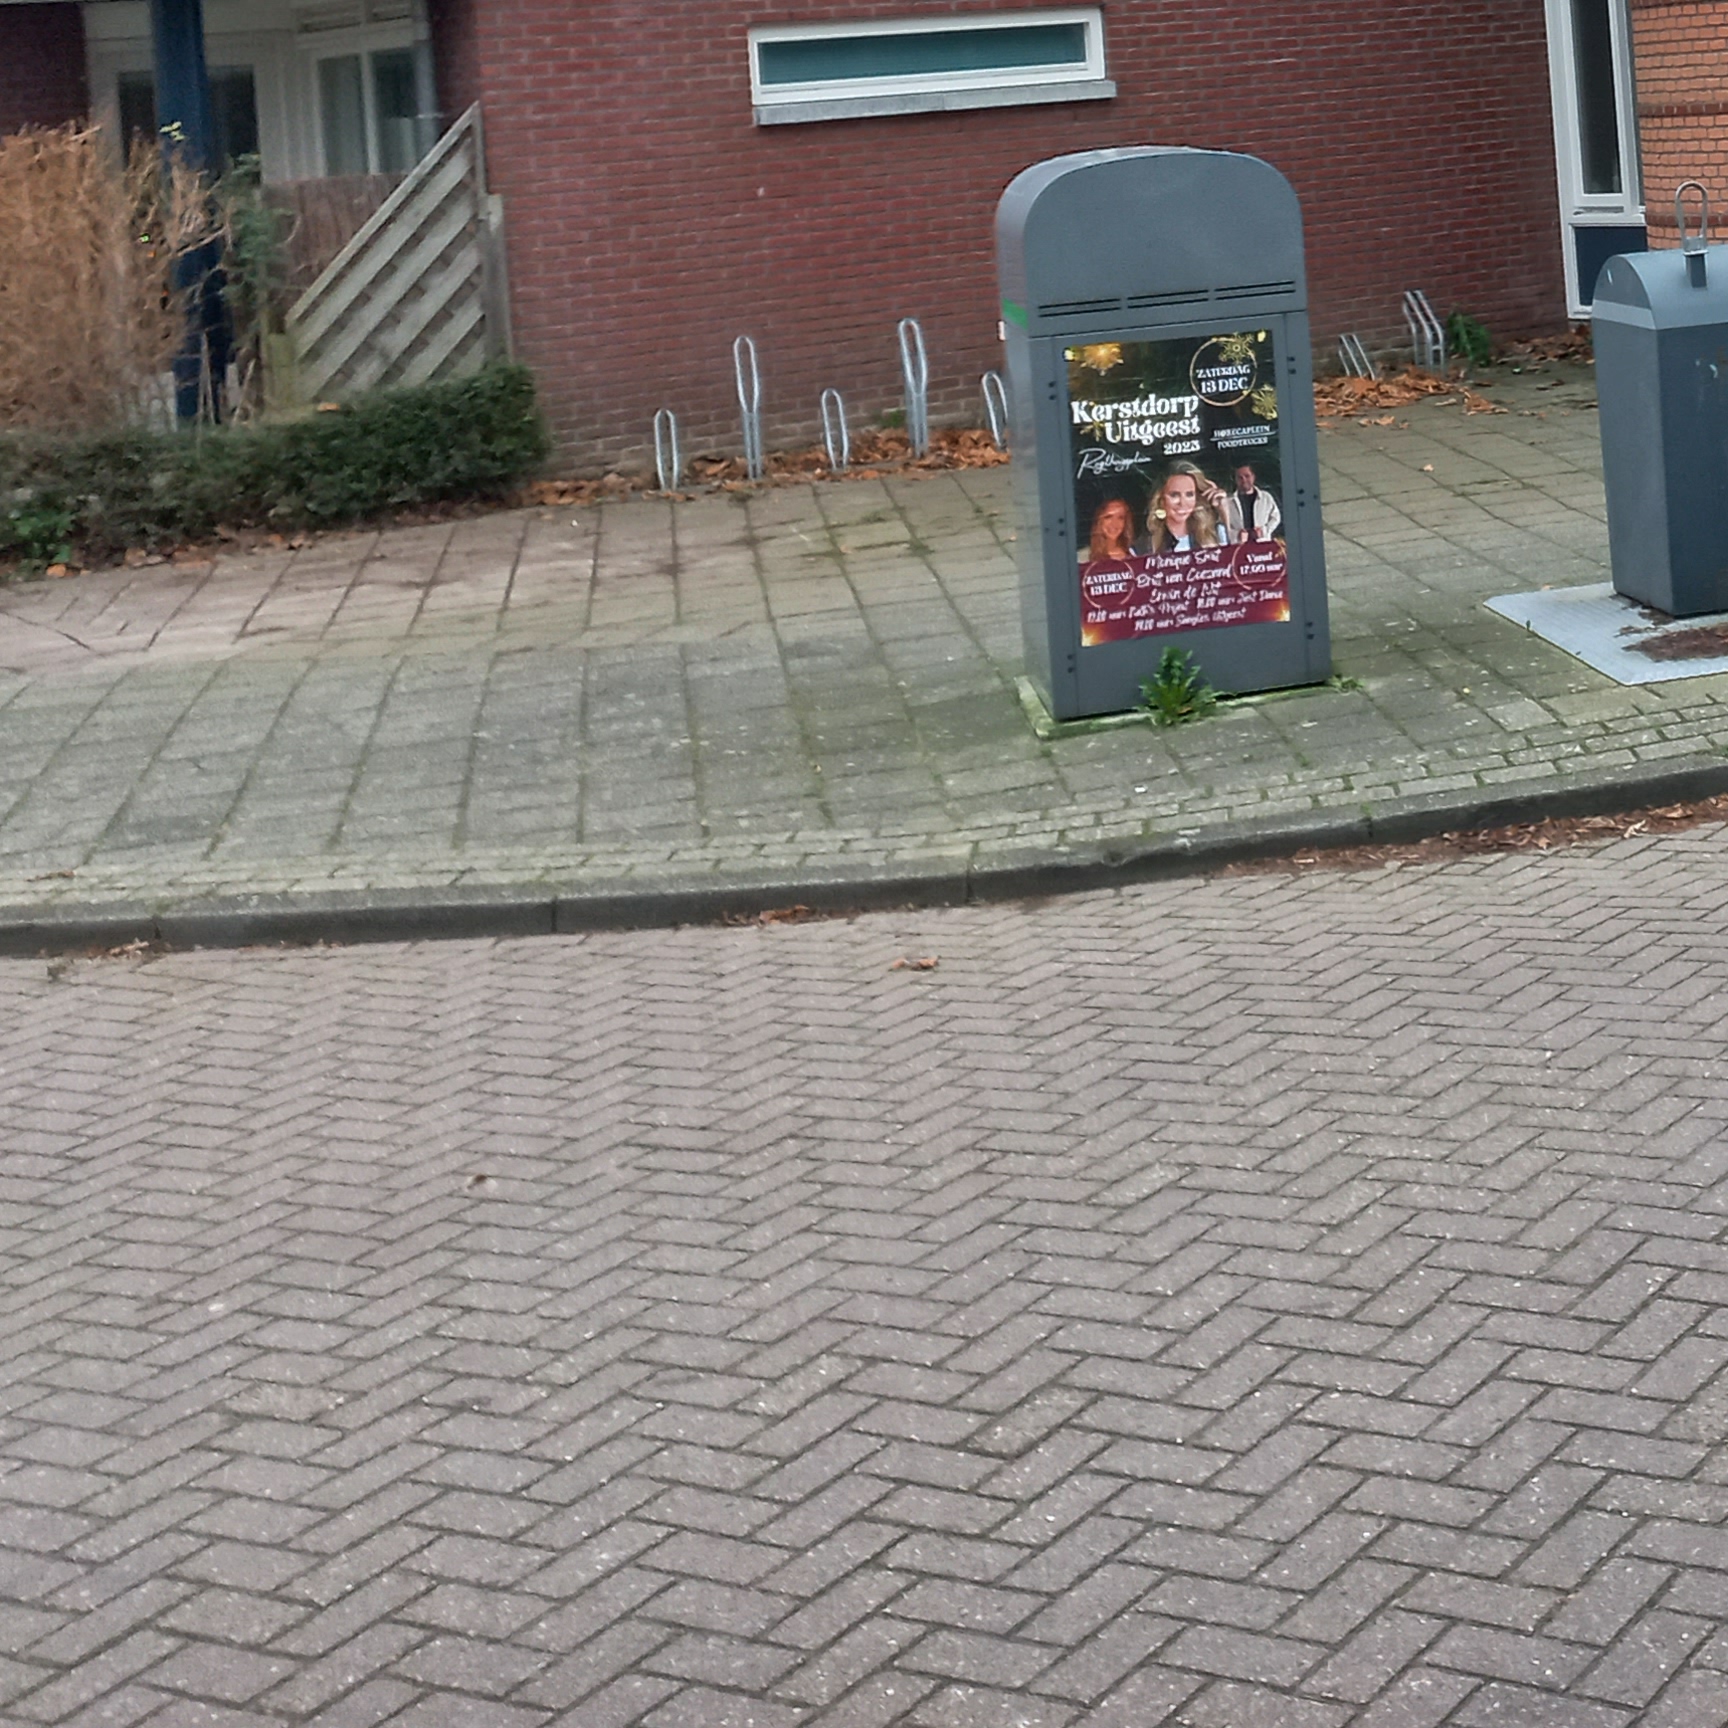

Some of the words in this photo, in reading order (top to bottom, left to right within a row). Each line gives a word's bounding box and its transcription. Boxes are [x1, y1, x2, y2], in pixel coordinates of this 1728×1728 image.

[1196, 364, 1250, 378] ZATERDAG
[1201, 381, 1216, 393] 13
[1218, 377, 1248, 392] DEC
[1070, 393, 1199, 424] Kerstdorp
[1105, 415, 1200, 445] Uitgeest
[1086, 572, 1132, 585] ZATERDAG
[1104, 582, 1127, 594] DEC
